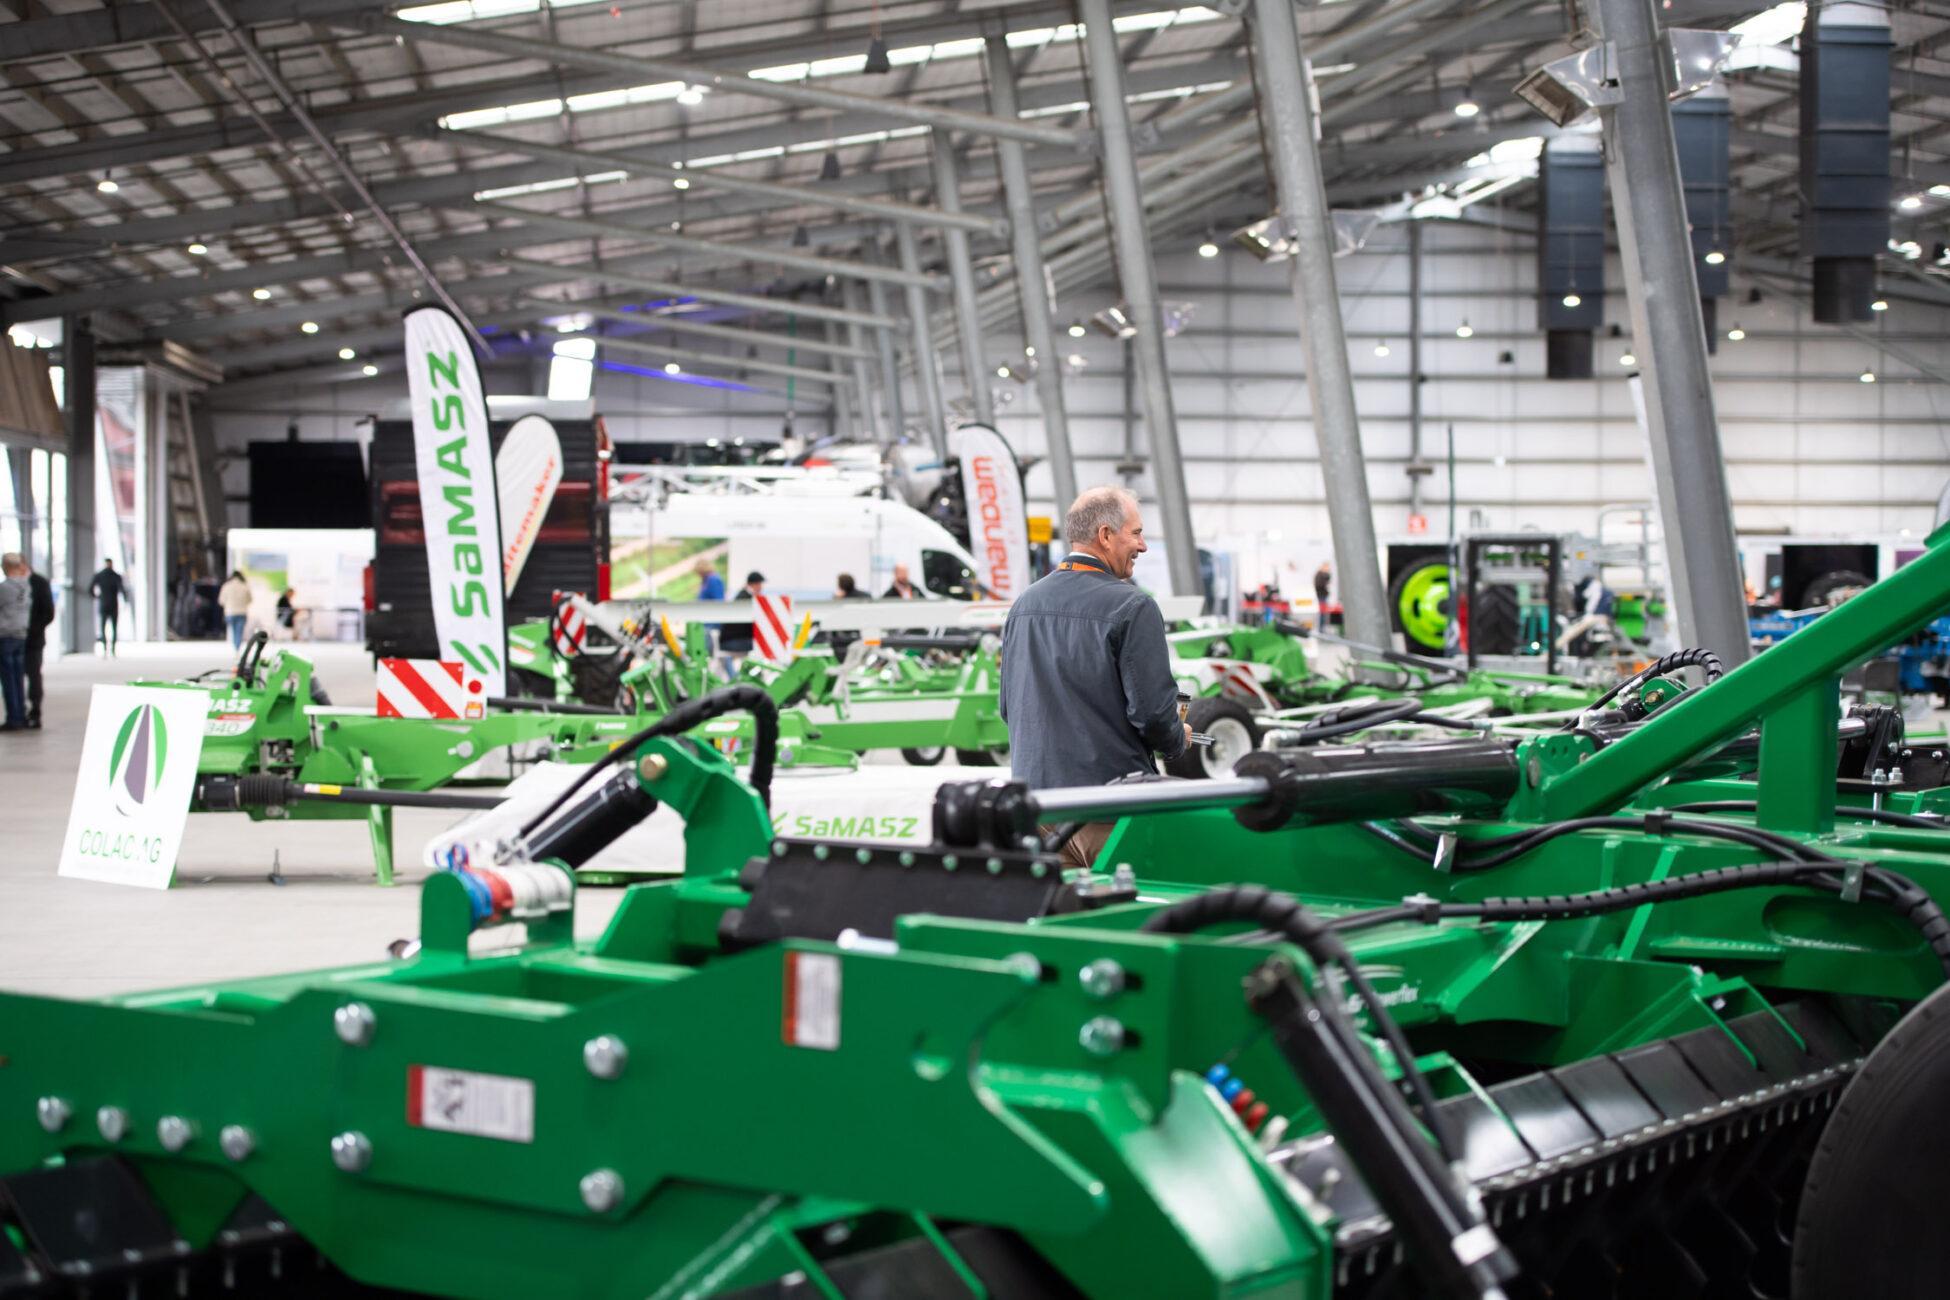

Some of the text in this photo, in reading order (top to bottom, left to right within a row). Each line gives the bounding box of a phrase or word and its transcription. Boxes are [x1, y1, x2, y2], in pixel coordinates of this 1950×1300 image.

[426, 351, 491, 618] SaMASZ
[793, 815, 919, 839] SaMASZ
[79, 829, 135, 860] COLAC
